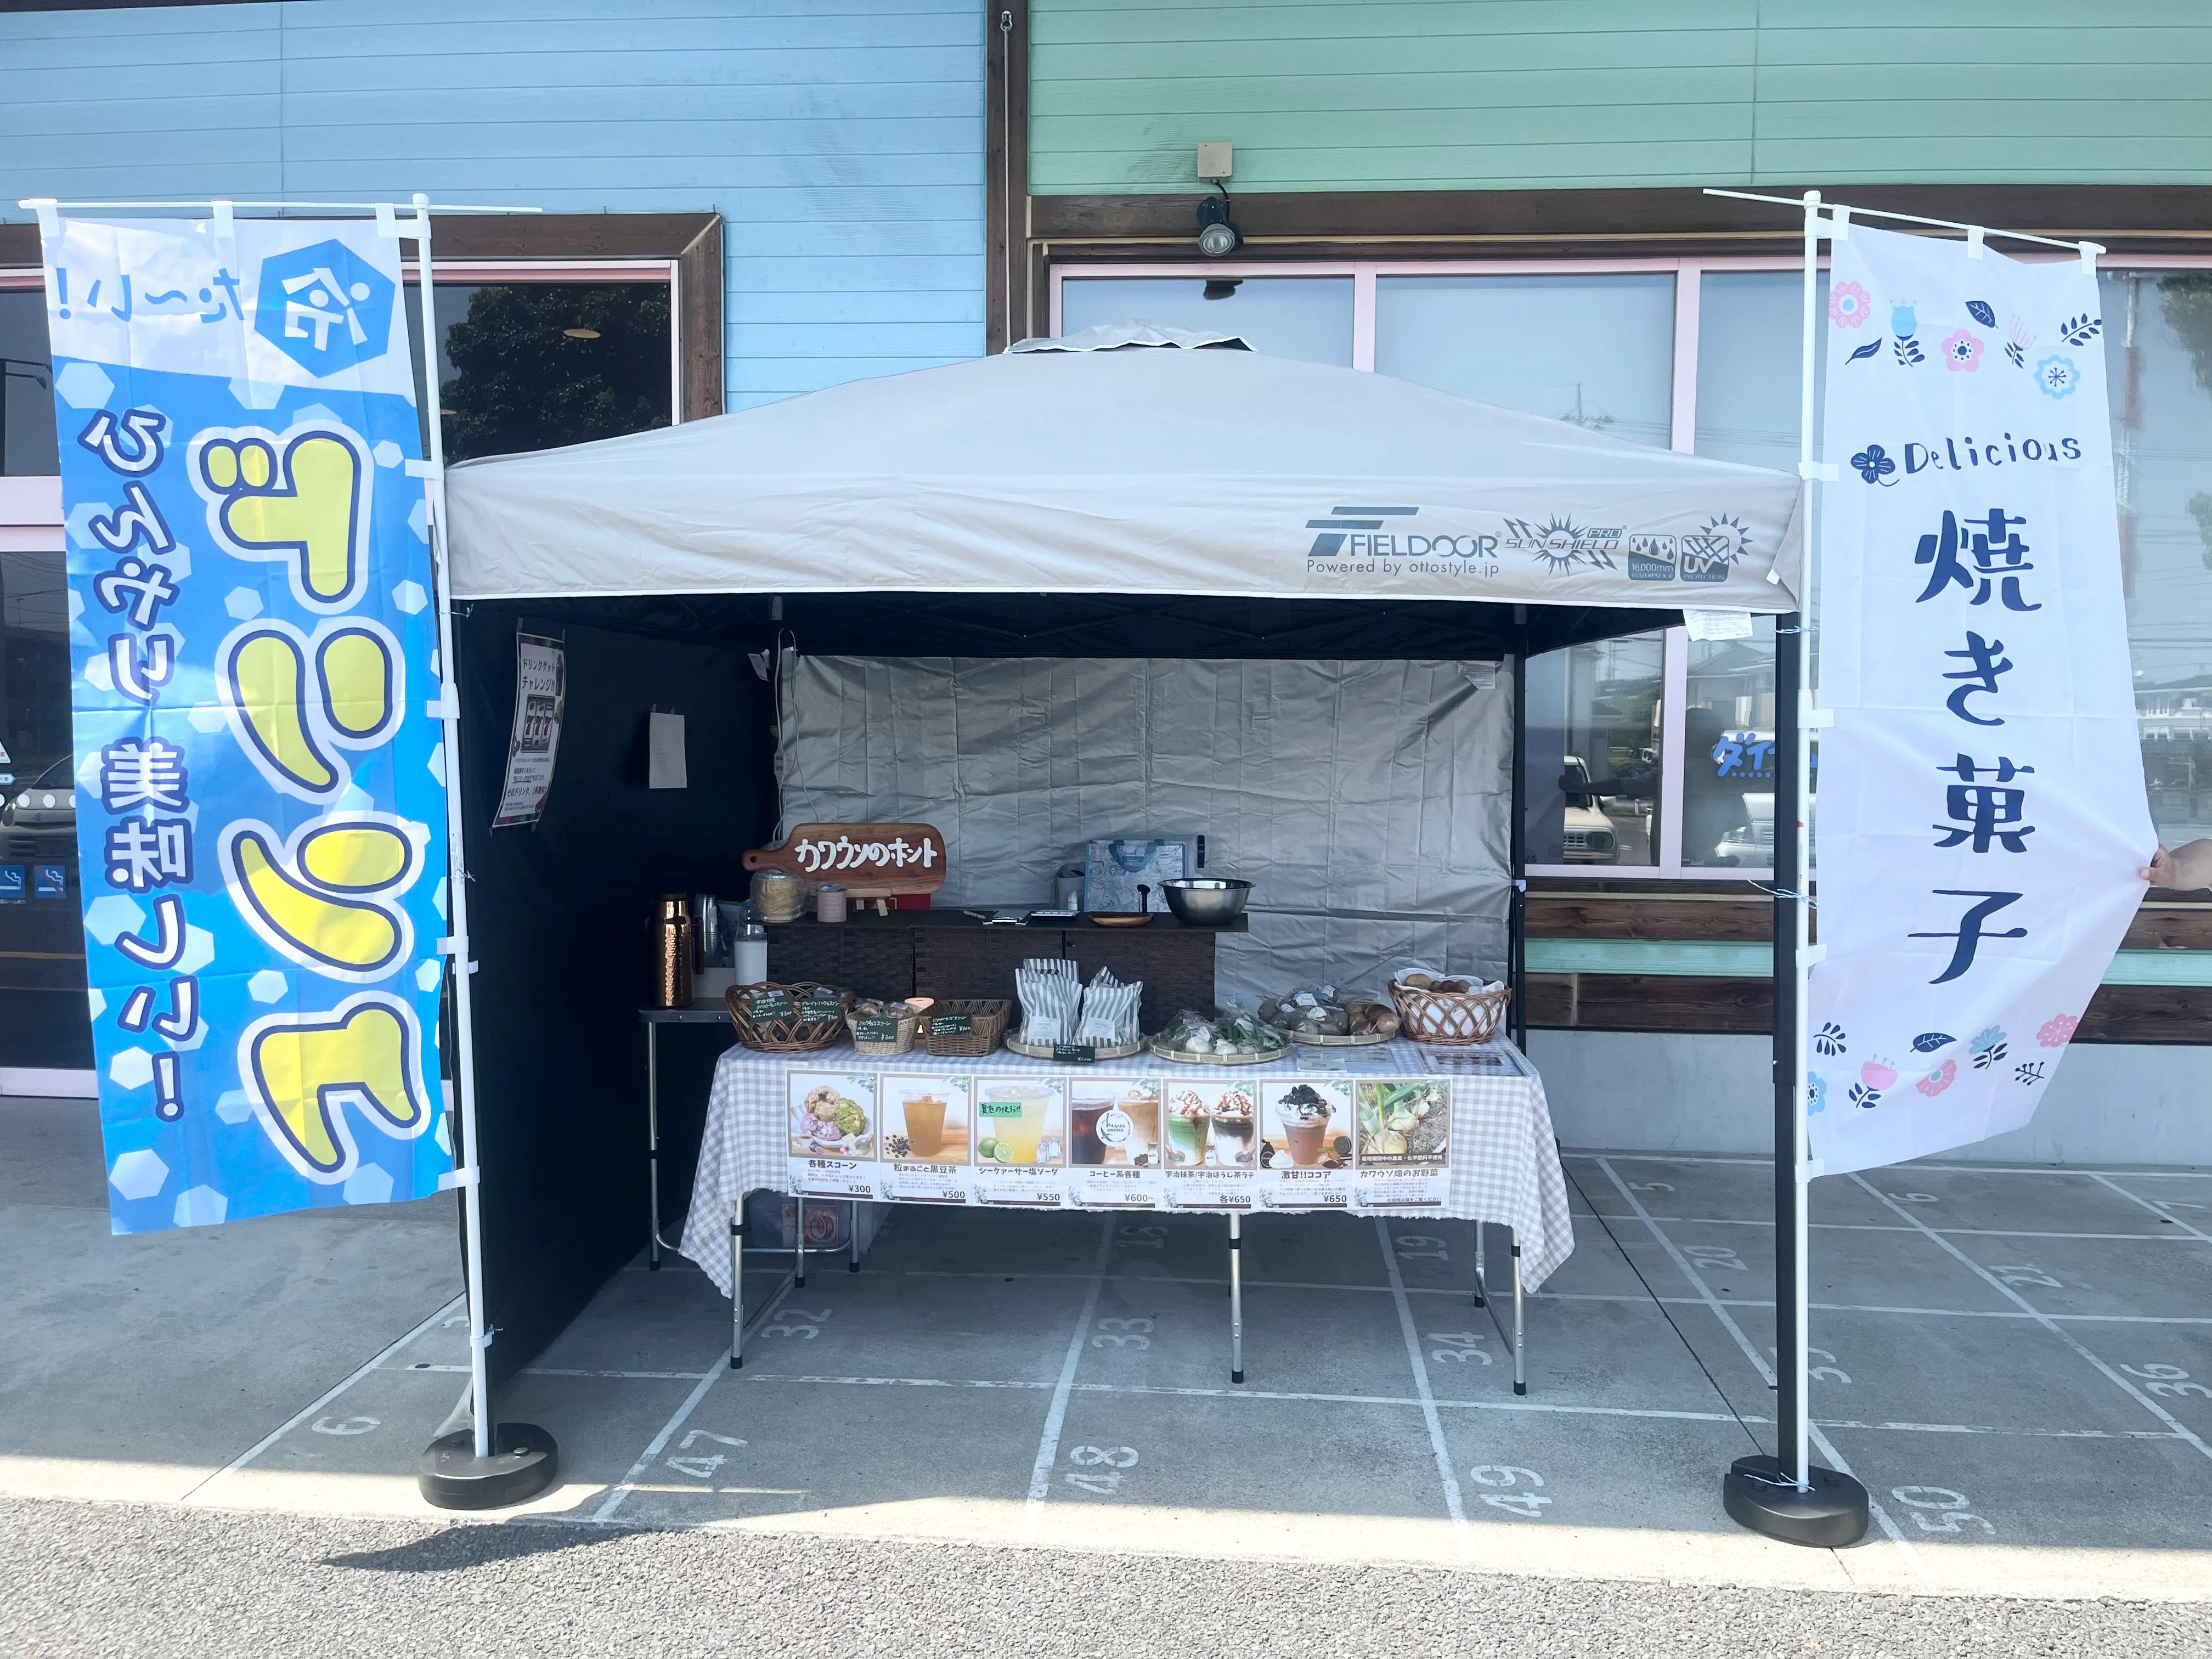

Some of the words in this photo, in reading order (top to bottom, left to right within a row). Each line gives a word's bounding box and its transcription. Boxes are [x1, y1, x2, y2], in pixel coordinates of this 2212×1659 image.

[1905, 432, 2082, 475] Delicious
[1589, 529, 1622, 538] PRO
[1350, 534, 1498, 558] FIELDOOR
[1307, 559, 1374, 573] Powered
[1383, 558, 1402, 576] by
[1409, 559, 1499, 578] ottostyle.jp
[1632, 563, 1673, 572] 16,000mm
[1684, 556, 1717, 573] UV
[1907, 507, 2043, 985] 焼き菓子
[794, 835, 938, 872] カワウソのホント
[881, 1032, 895, 1041] ¥300
[808, 1159, 857, 1170] 各種スコーン
[893, 1163, 957, 1174] 粒まるごと黒豆茶
[979, 1167, 1059, 1176] シークァーサー塩ソーダ
[1090, 1170, 1141, 1178] コーヒー系各種
[1165, 1170, 1255, 1179] 宇治抹茶/宇治ほうじ茶ラテ
[1281, 1170, 1331, 1179] 激甘!!ココア
[1360, 1169, 1439, 1178] カワウソ畑のお野菜
[848, 1184, 871, 1193] ¥300
[1628, 1182, 1675, 1192] 5
[942, 1190, 966, 1199] ¥500
[1037, 1193, 1060, 1201] ¥550
[1220, 1195, 1251, 1204] 各¥650
[1887, 1192, 1938, 1203] 6
[2152, 1200, 2207, 1209] 7
[1115, 1224, 1167, 1249] 18
[1395, 1235, 1449, 1261] 19
[1683, 1245, 1749, 1271] 20
[761, 1308, 833, 1340] 32
[1092, 1317, 1154, 1350] 33
[1427, 1331, 1493, 1365] 34
[2120, 1363, 2212, 1398] 36
[665, 1429, 748, 1479] 47
[1064, 1445, 1139, 1495] 48
[1470, 1464, 1553, 1518] 49
[1891, 1485, 1995, 1535] 50
